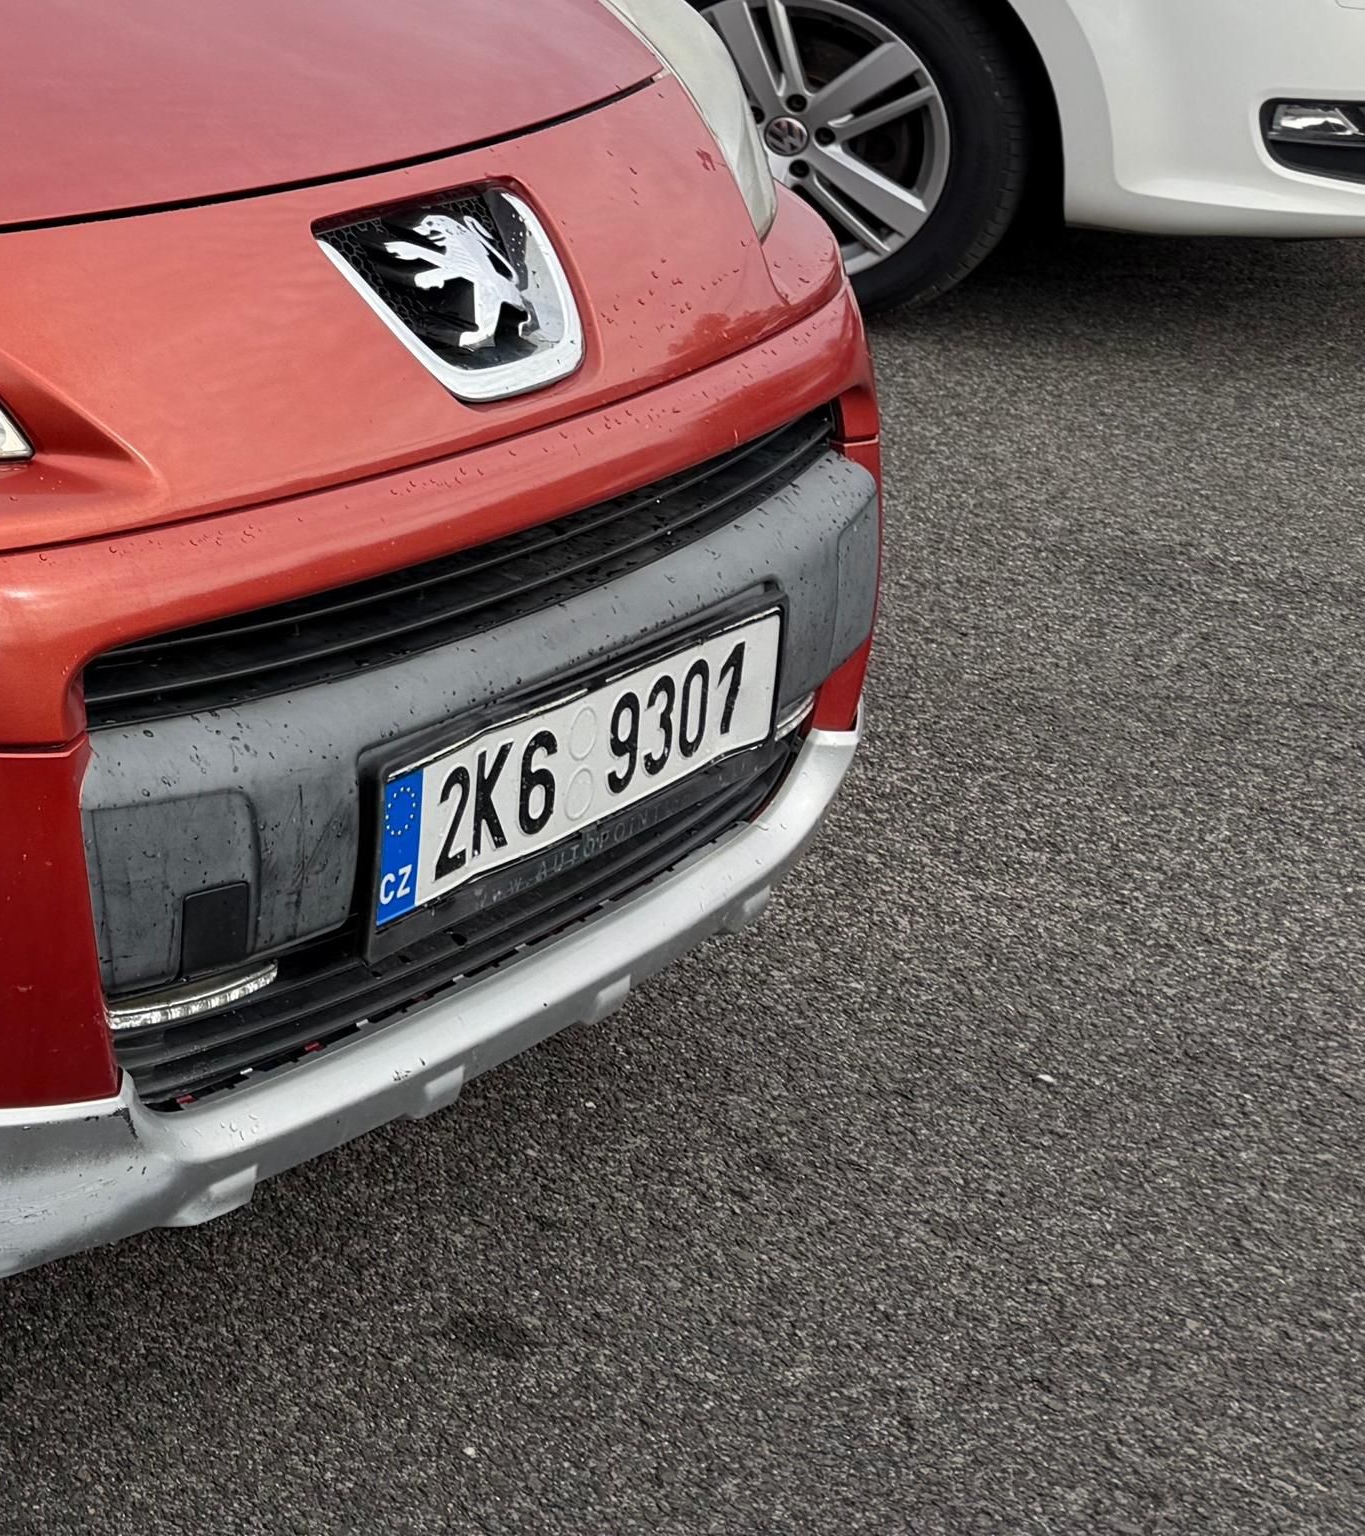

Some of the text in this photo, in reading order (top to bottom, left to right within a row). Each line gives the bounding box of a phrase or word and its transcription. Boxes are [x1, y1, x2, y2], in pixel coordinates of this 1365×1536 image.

[435, 640, 747, 881] 2K6 9301
[379, 865, 412, 906] CZ
